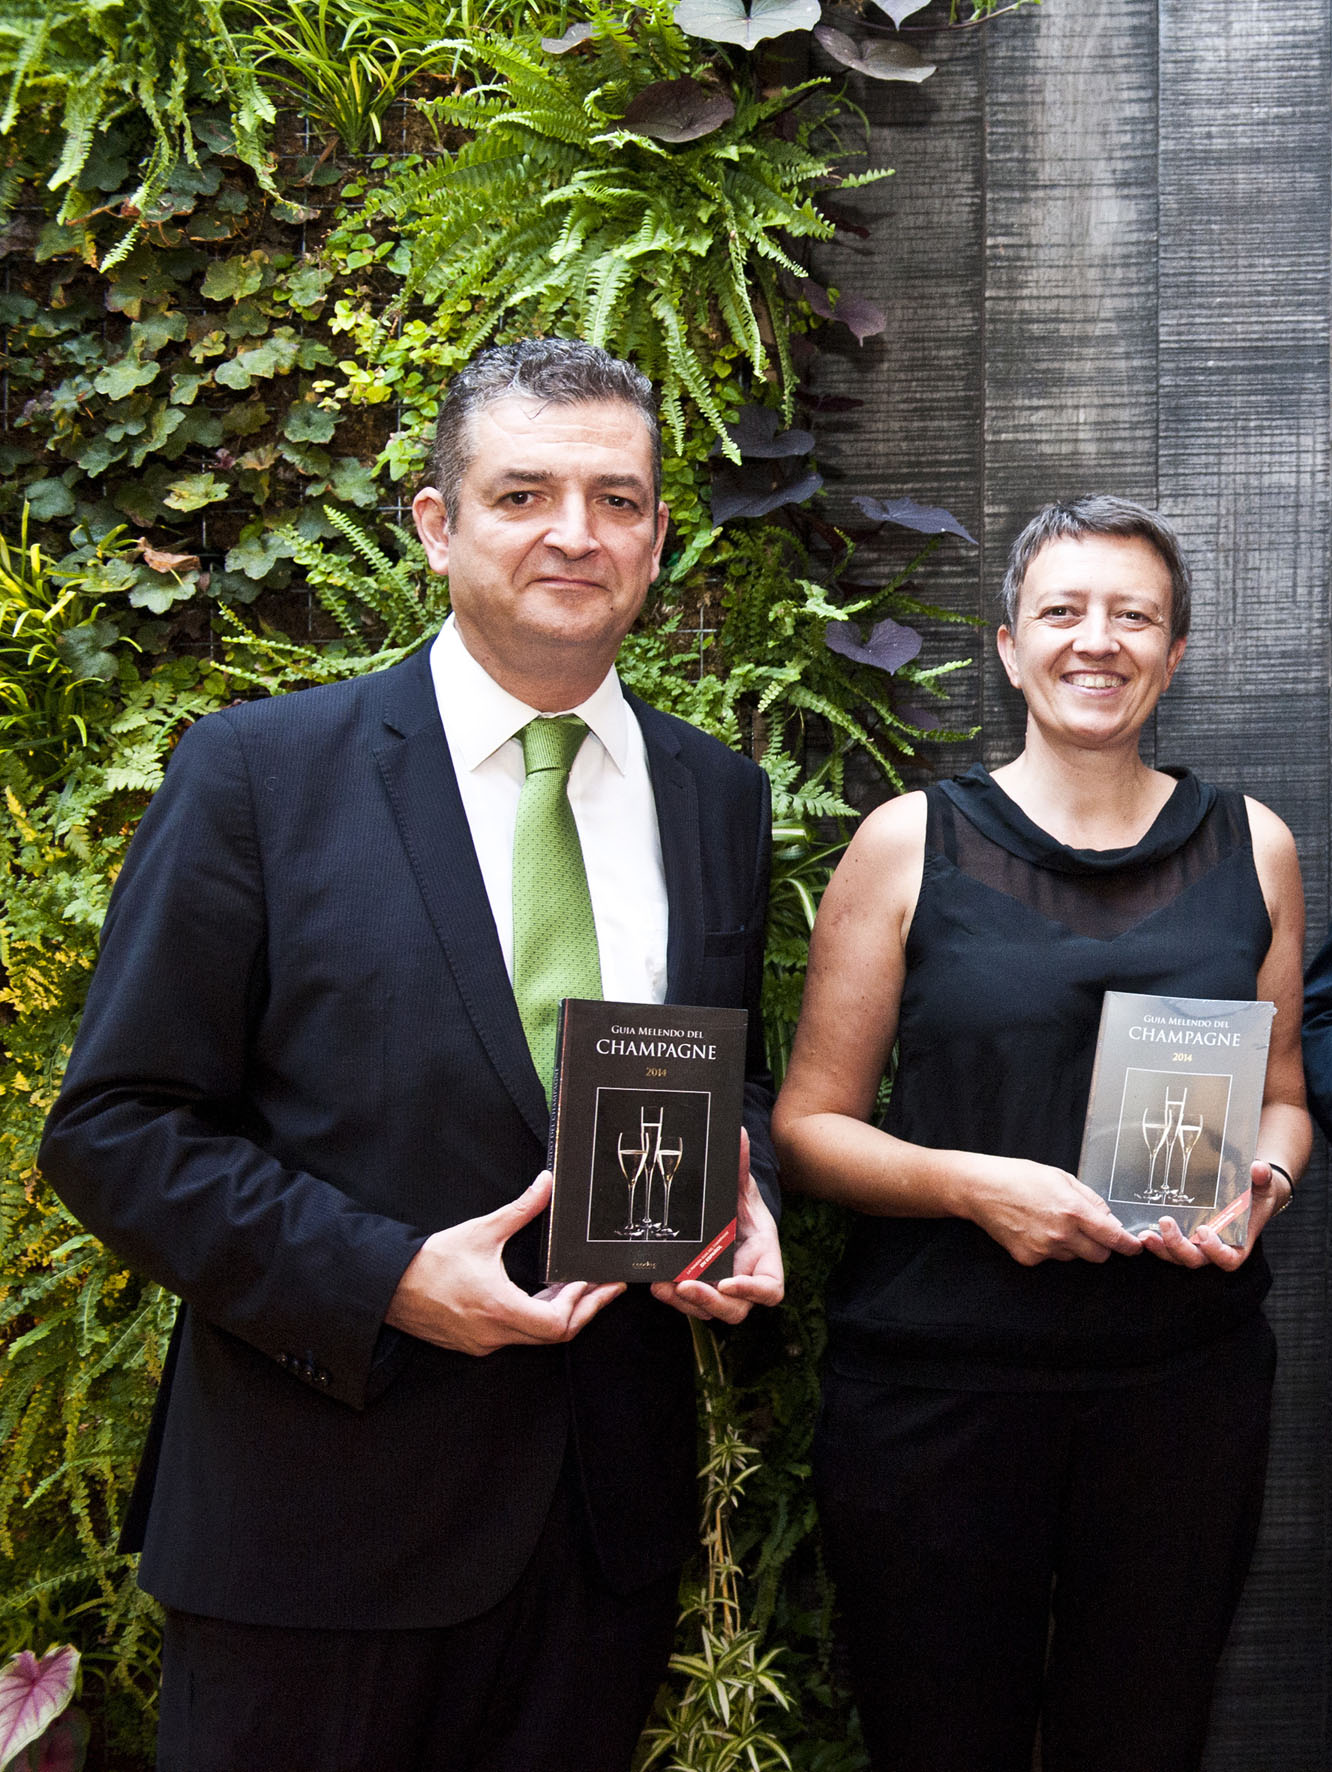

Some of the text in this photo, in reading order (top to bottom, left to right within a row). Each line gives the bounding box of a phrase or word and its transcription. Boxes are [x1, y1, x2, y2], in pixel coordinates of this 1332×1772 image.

[1143, 1014, 1230, 1029] GUIA MELENDO DEL
[611, 1025, 704, 1039] GUIA MELENDO DEL
[1128, 1026, 1241, 1047] CHAMPAGNE
[597, 1039, 717, 1060] CHAMPAGNE
[1172, 1052, 1193, 1062] 2014
[645, 1067, 667, 1077] 2014
